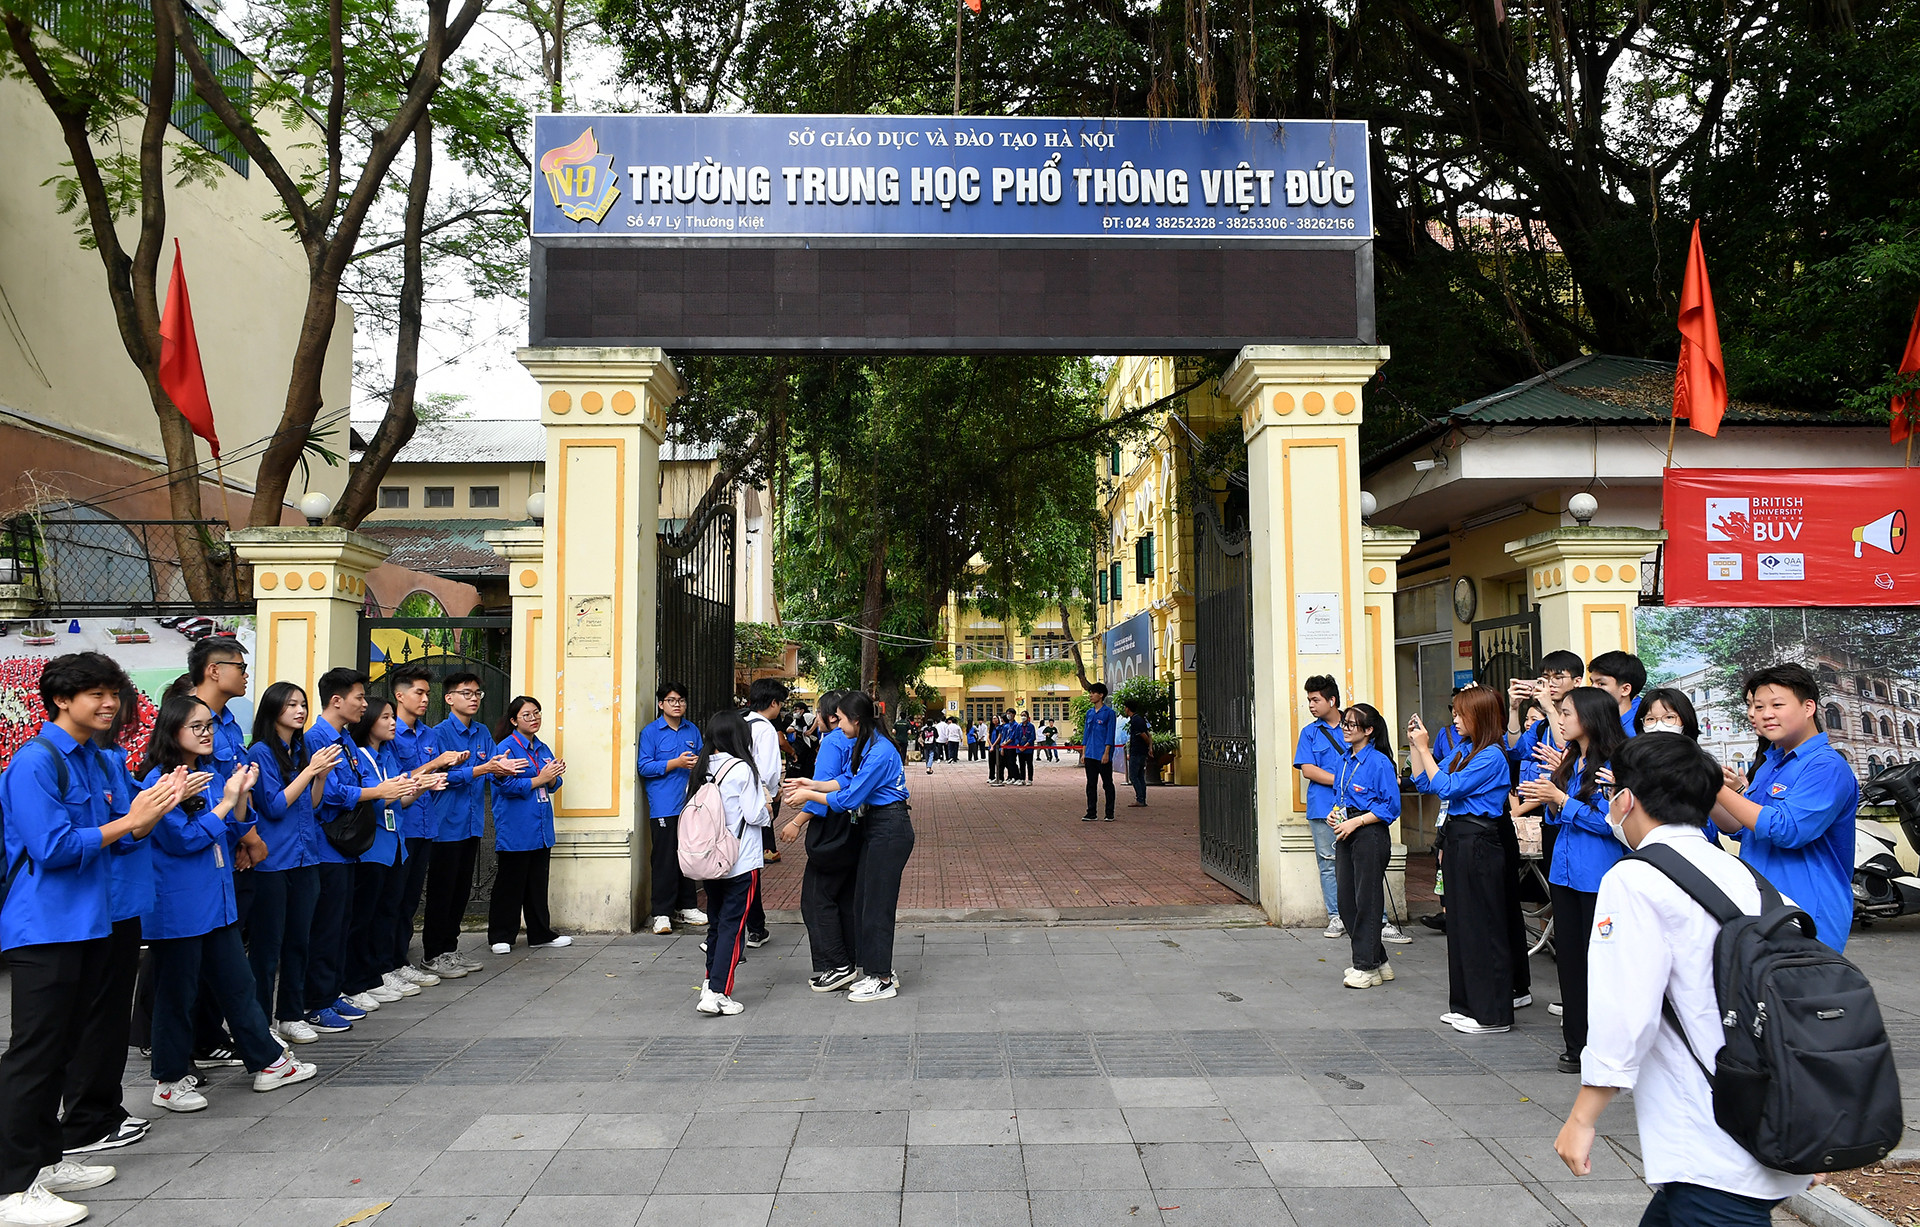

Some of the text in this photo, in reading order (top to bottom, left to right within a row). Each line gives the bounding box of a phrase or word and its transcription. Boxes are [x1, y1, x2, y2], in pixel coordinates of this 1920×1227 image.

[788, 127, 1115, 151] SỞ GIÁO DỤC VÀ ĐÀO TẠO HÀ NỘI
[553, 166, 597, 197] VĐ
[628, 153, 1356, 213] TRƯỜNG TRUNG HỌC PHỔ THÔNG VIỆT ĐỨC
[626, 213, 765, 231] Số 47 Lý Thường Kiệt
[1103, 217, 1124, 230] ĐT:
[1126, 217, 1150, 230] 024
[1155, 217, 1217, 230] 38252328
[1226, 217, 1288, 230] 38253306
[1296, 217, 1356, 230] 38262156
[1753, 497, 1803, 507] BRITISH
[1753, 521, 1803, 542] BUV
[1784, 557, 1802, 565] QAA
[950, 701, 956, 710] B
